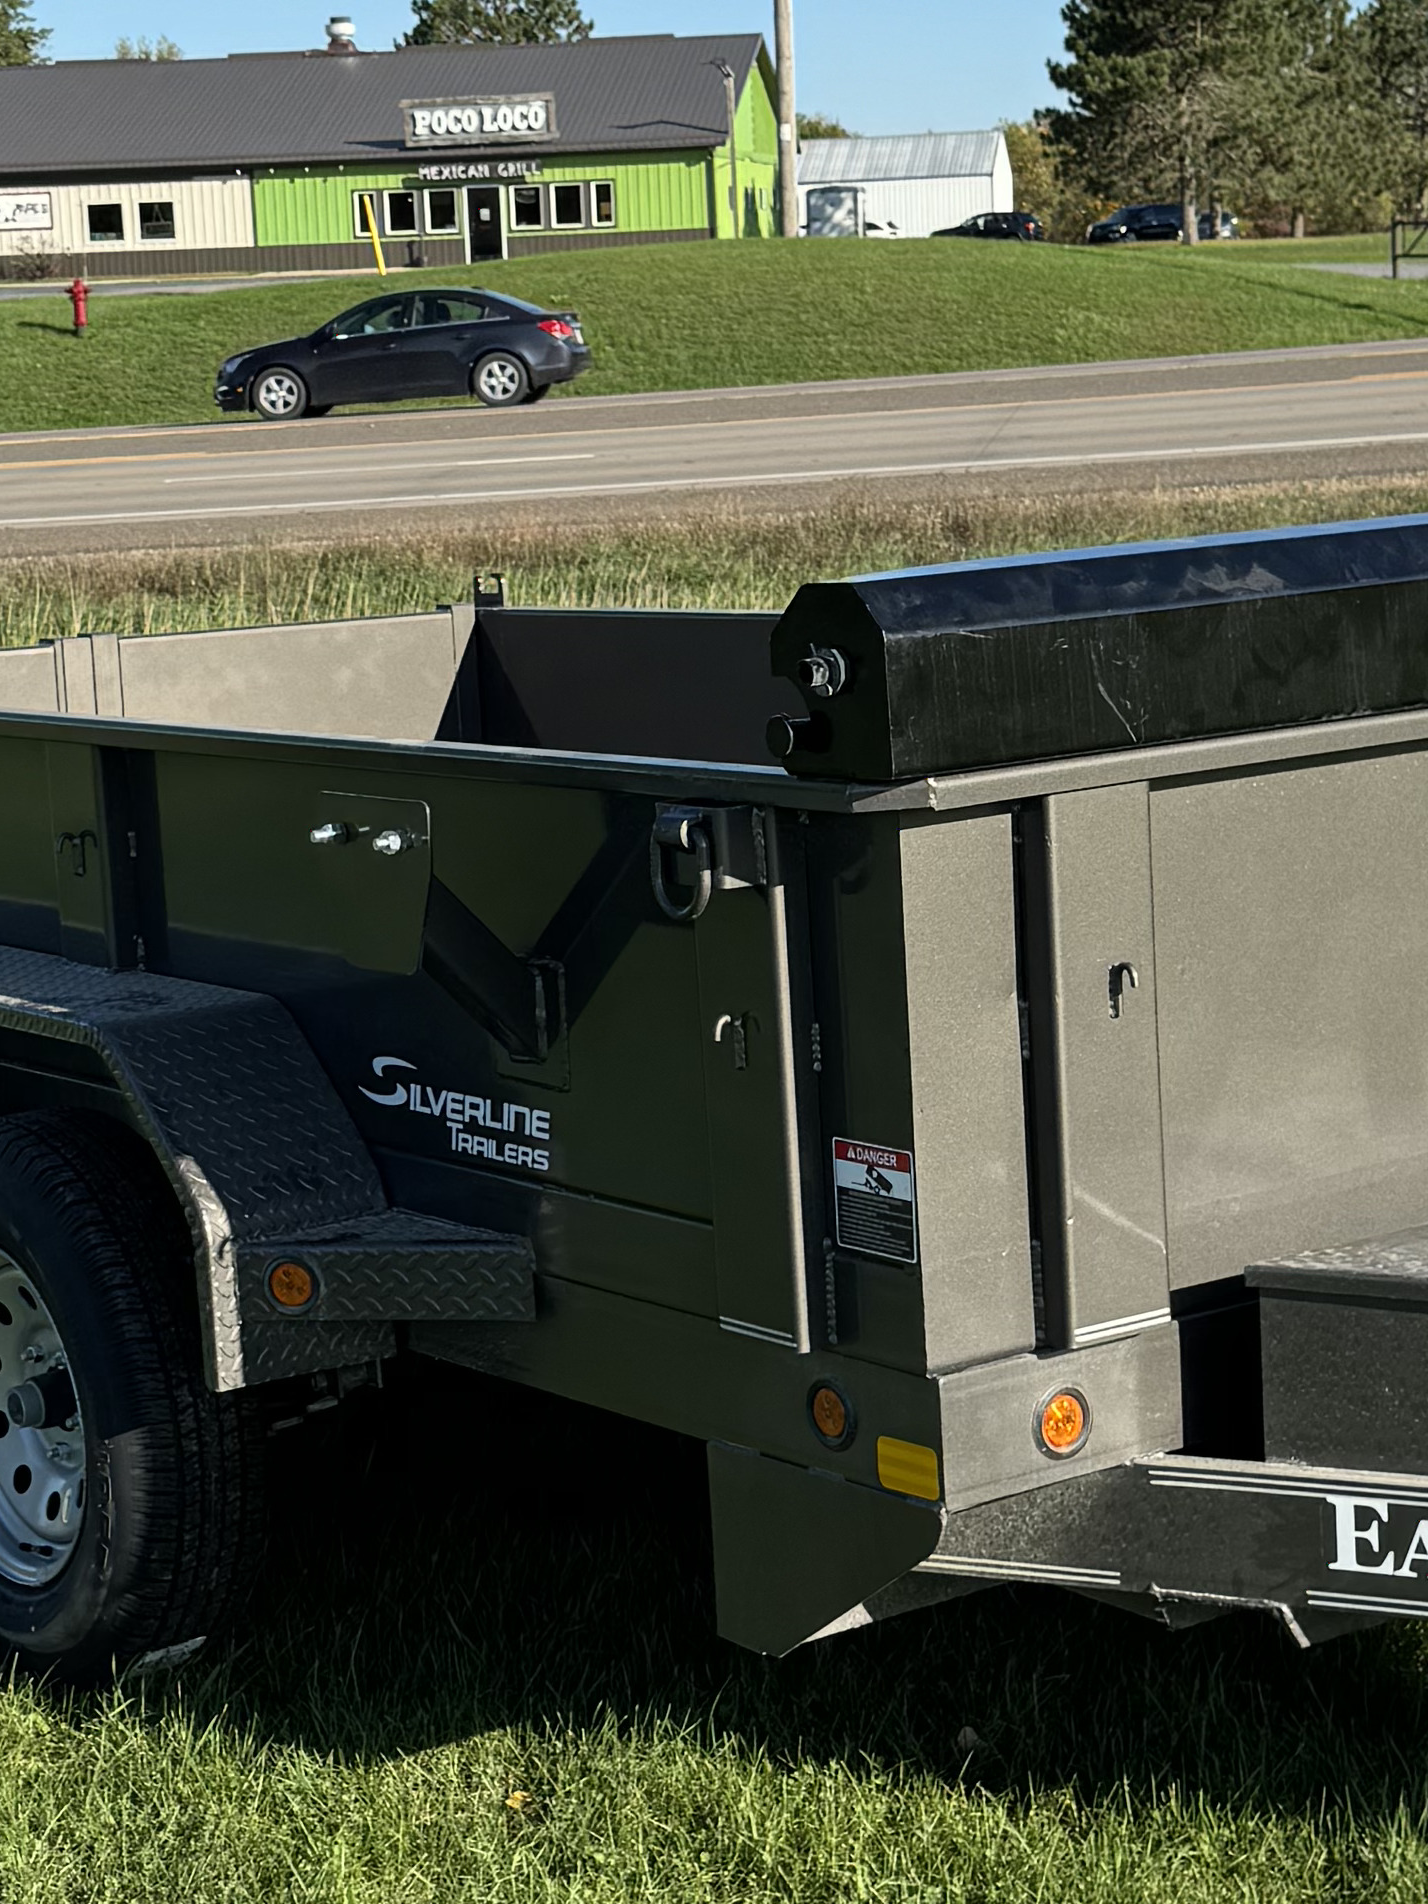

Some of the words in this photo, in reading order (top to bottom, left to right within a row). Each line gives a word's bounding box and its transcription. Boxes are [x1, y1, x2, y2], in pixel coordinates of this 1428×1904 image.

[413, 108, 478, 135] POCO
[481, 104, 546, 132] LOCO
[418, 164, 490, 180] MEXICAN
[497, 161, 541, 177] GRILL
[358, 1056, 551, 1140] SILVERLINE
[446, 1121, 550, 1171] TRAILERS
[856, 1147, 897, 1167] DANGER
